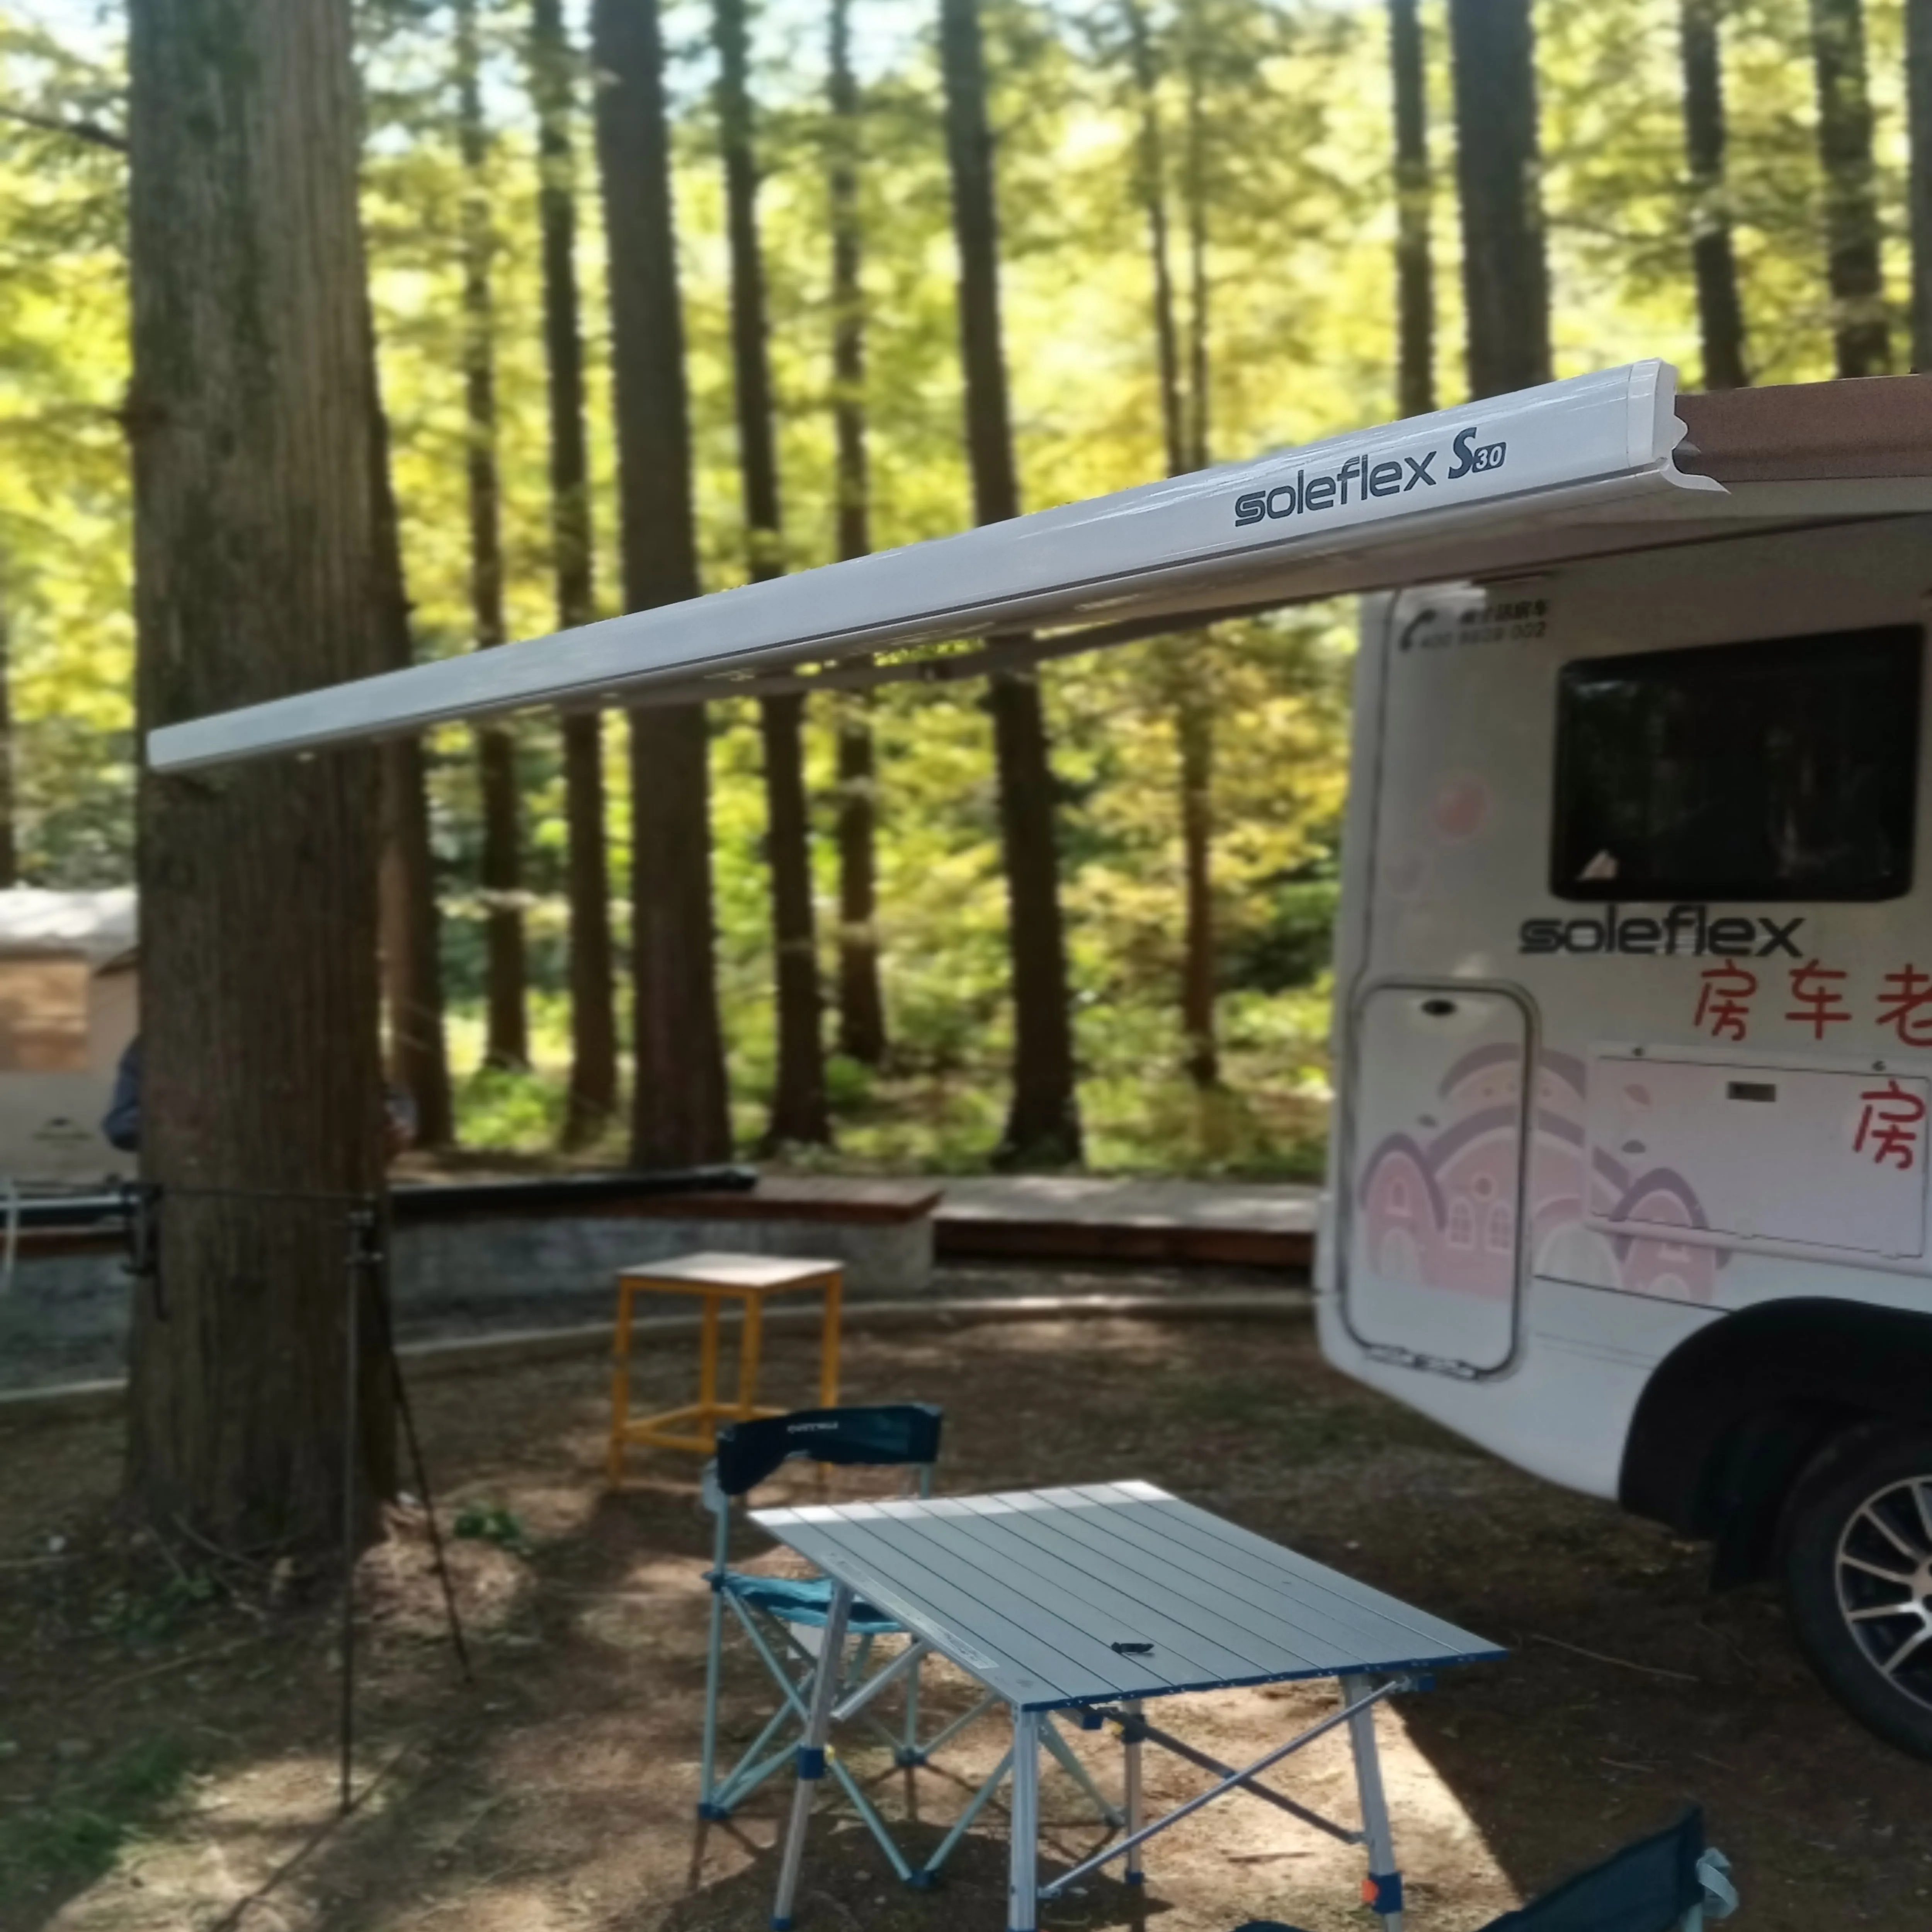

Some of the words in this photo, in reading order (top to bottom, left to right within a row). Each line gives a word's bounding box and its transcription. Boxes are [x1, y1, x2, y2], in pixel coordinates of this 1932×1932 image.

[1235, 450, 1437, 527] soleflex
[1518, 904, 1806, 957] soleflex
[1692, 959, 1932, 1046] 房车老
[1853, 1079, 1926, 1170] 房
